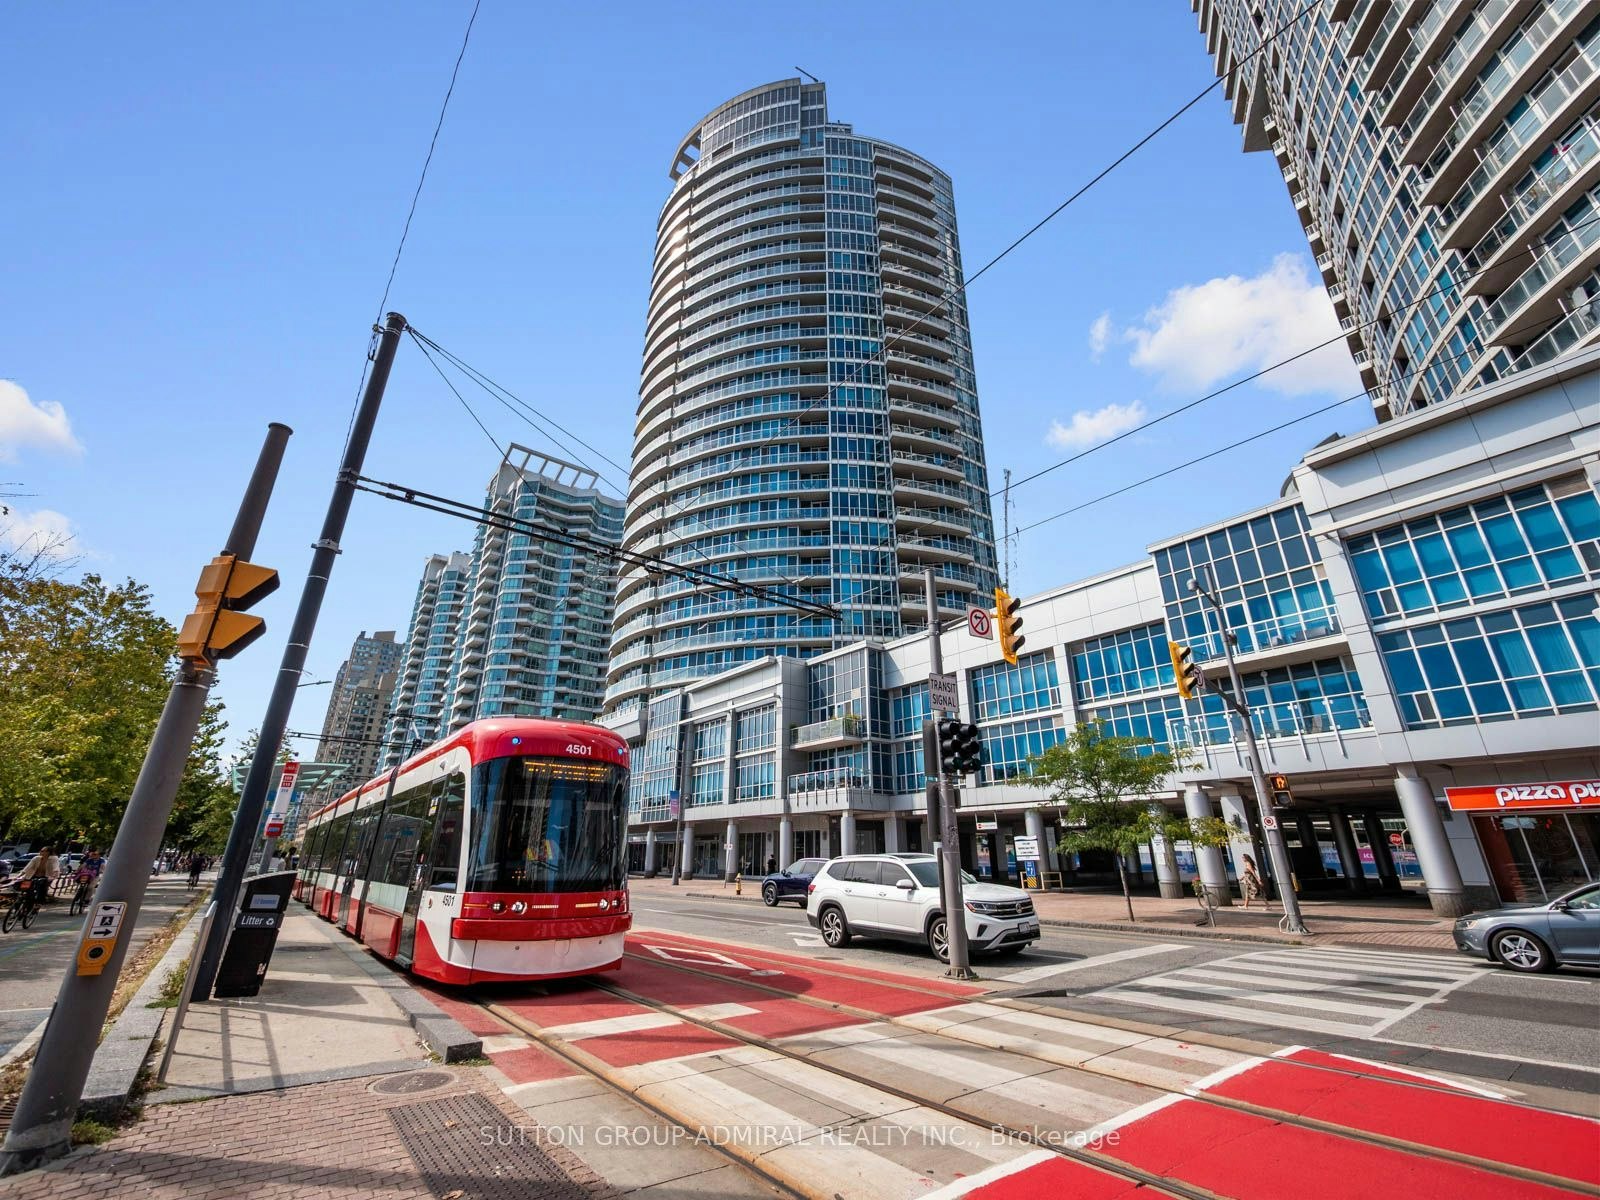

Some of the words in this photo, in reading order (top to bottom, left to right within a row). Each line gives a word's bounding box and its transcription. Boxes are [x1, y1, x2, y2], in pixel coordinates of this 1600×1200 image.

[931, 679, 956, 694] TRANSIT
[932, 694, 956, 707] SIGNAL
[565, 744, 592, 755] 4501
[1495, 785, 1566, 807] pizza
[442, 894, 456, 907] 4501
[241, 915, 264, 925] Litter
